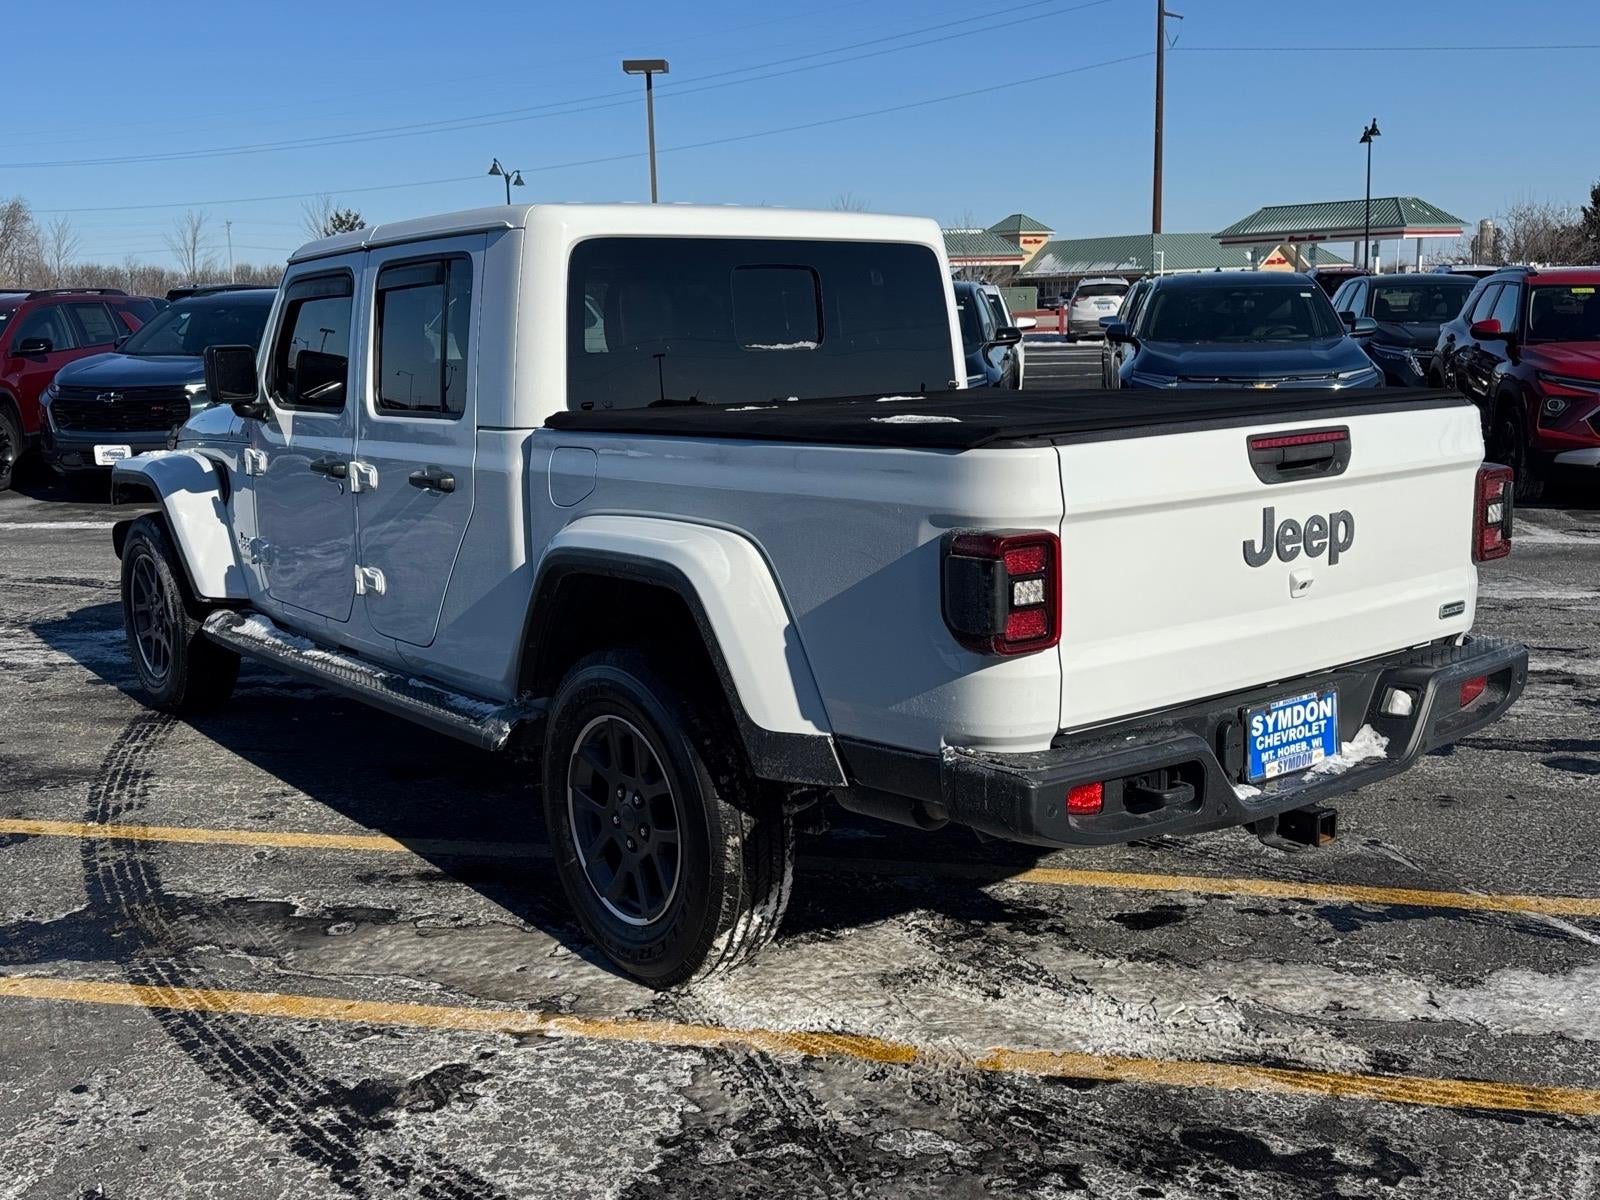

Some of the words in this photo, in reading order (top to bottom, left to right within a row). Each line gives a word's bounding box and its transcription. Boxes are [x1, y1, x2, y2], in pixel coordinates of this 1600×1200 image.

[1243, 506, 1355, 568] Jeep
[1252, 697, 1332, 736] SYMDON
[1256, 720, 1327, 751] CHEVROLET
[1261, 750, 1275, 762] MT.
[1278, 741, 1310, 758] HOREB,
[1312, 737, 1322, 748] WI
[1277, 751, 1314, 774] SYMDON
